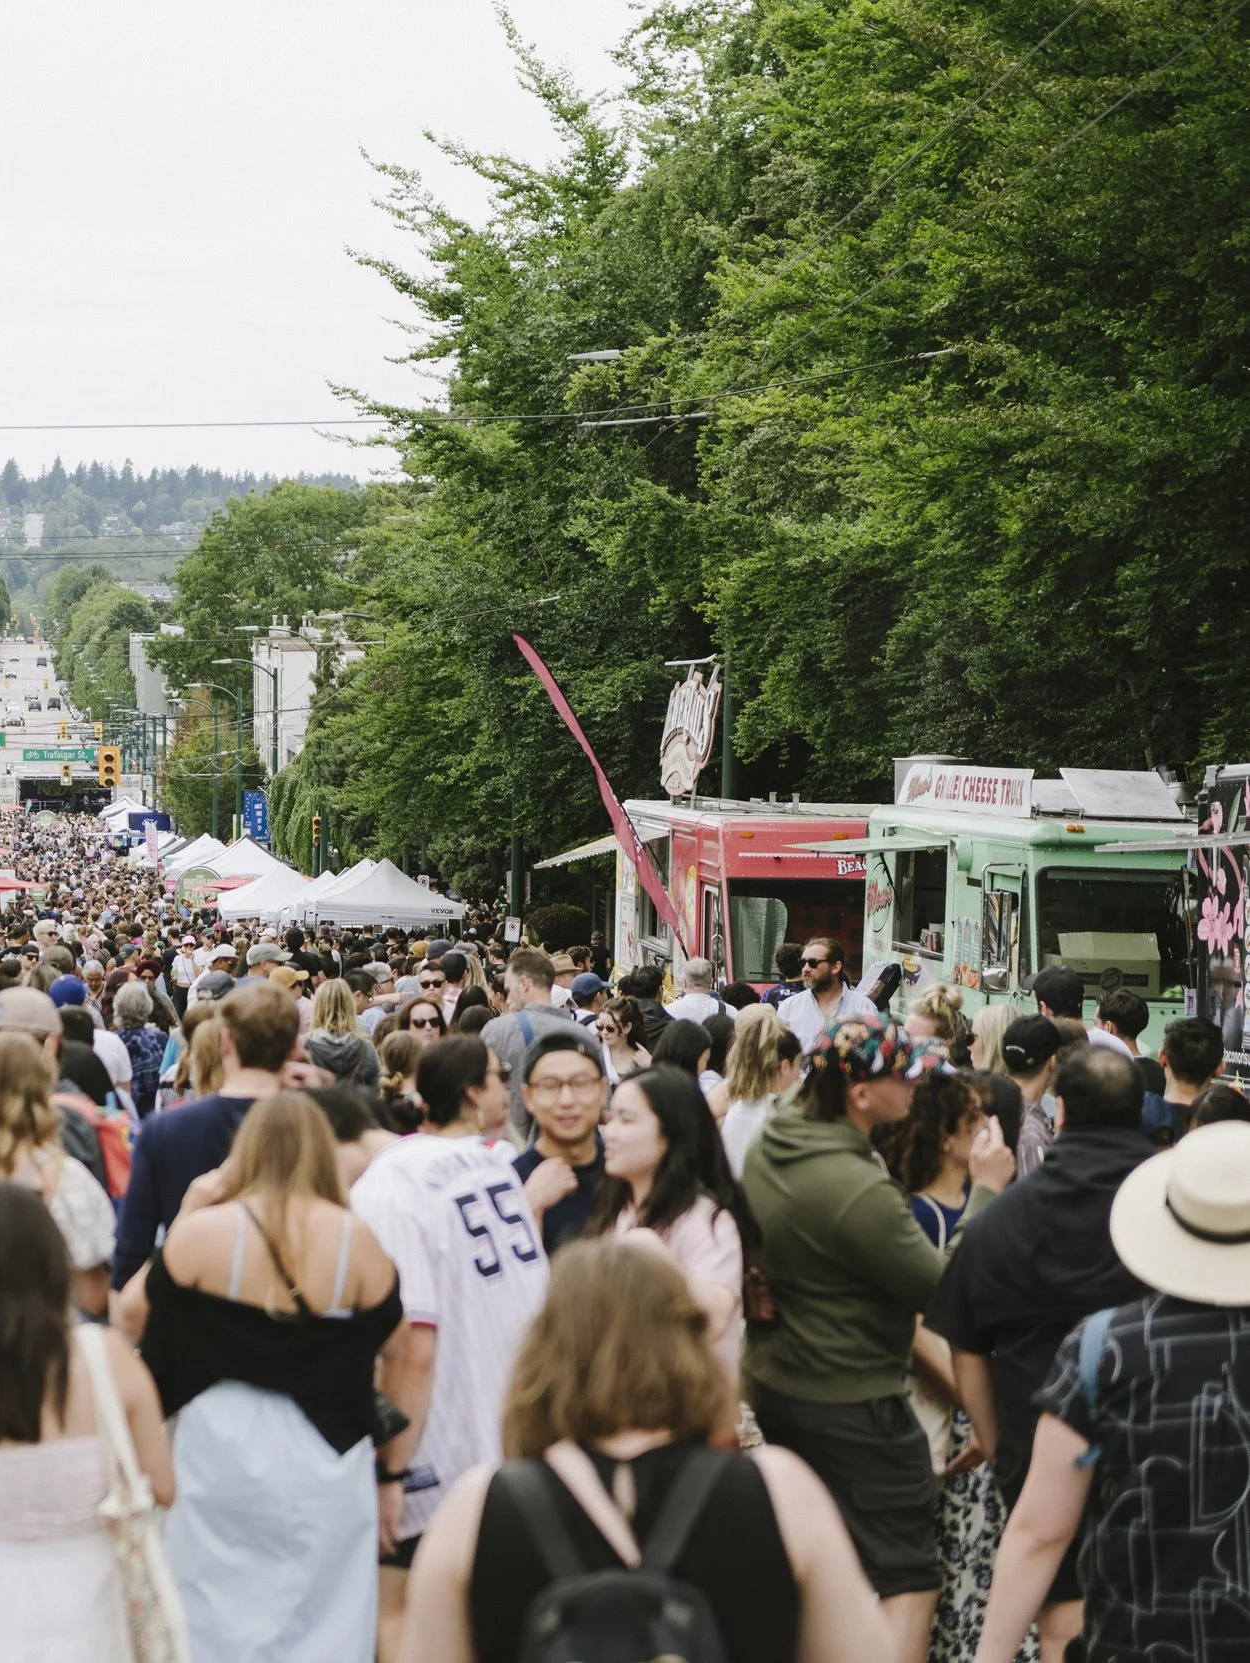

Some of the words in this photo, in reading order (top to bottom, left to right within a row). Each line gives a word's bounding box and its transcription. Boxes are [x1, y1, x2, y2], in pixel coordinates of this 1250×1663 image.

[43, 750, 76, 760] Trafalgar
[77, 750, 88, 759] St.
[963, 776, 998, 803] CHEESE
[1001, 779, 1024, 805] TRUCK
[455, 1182, 538, 1277] 55
